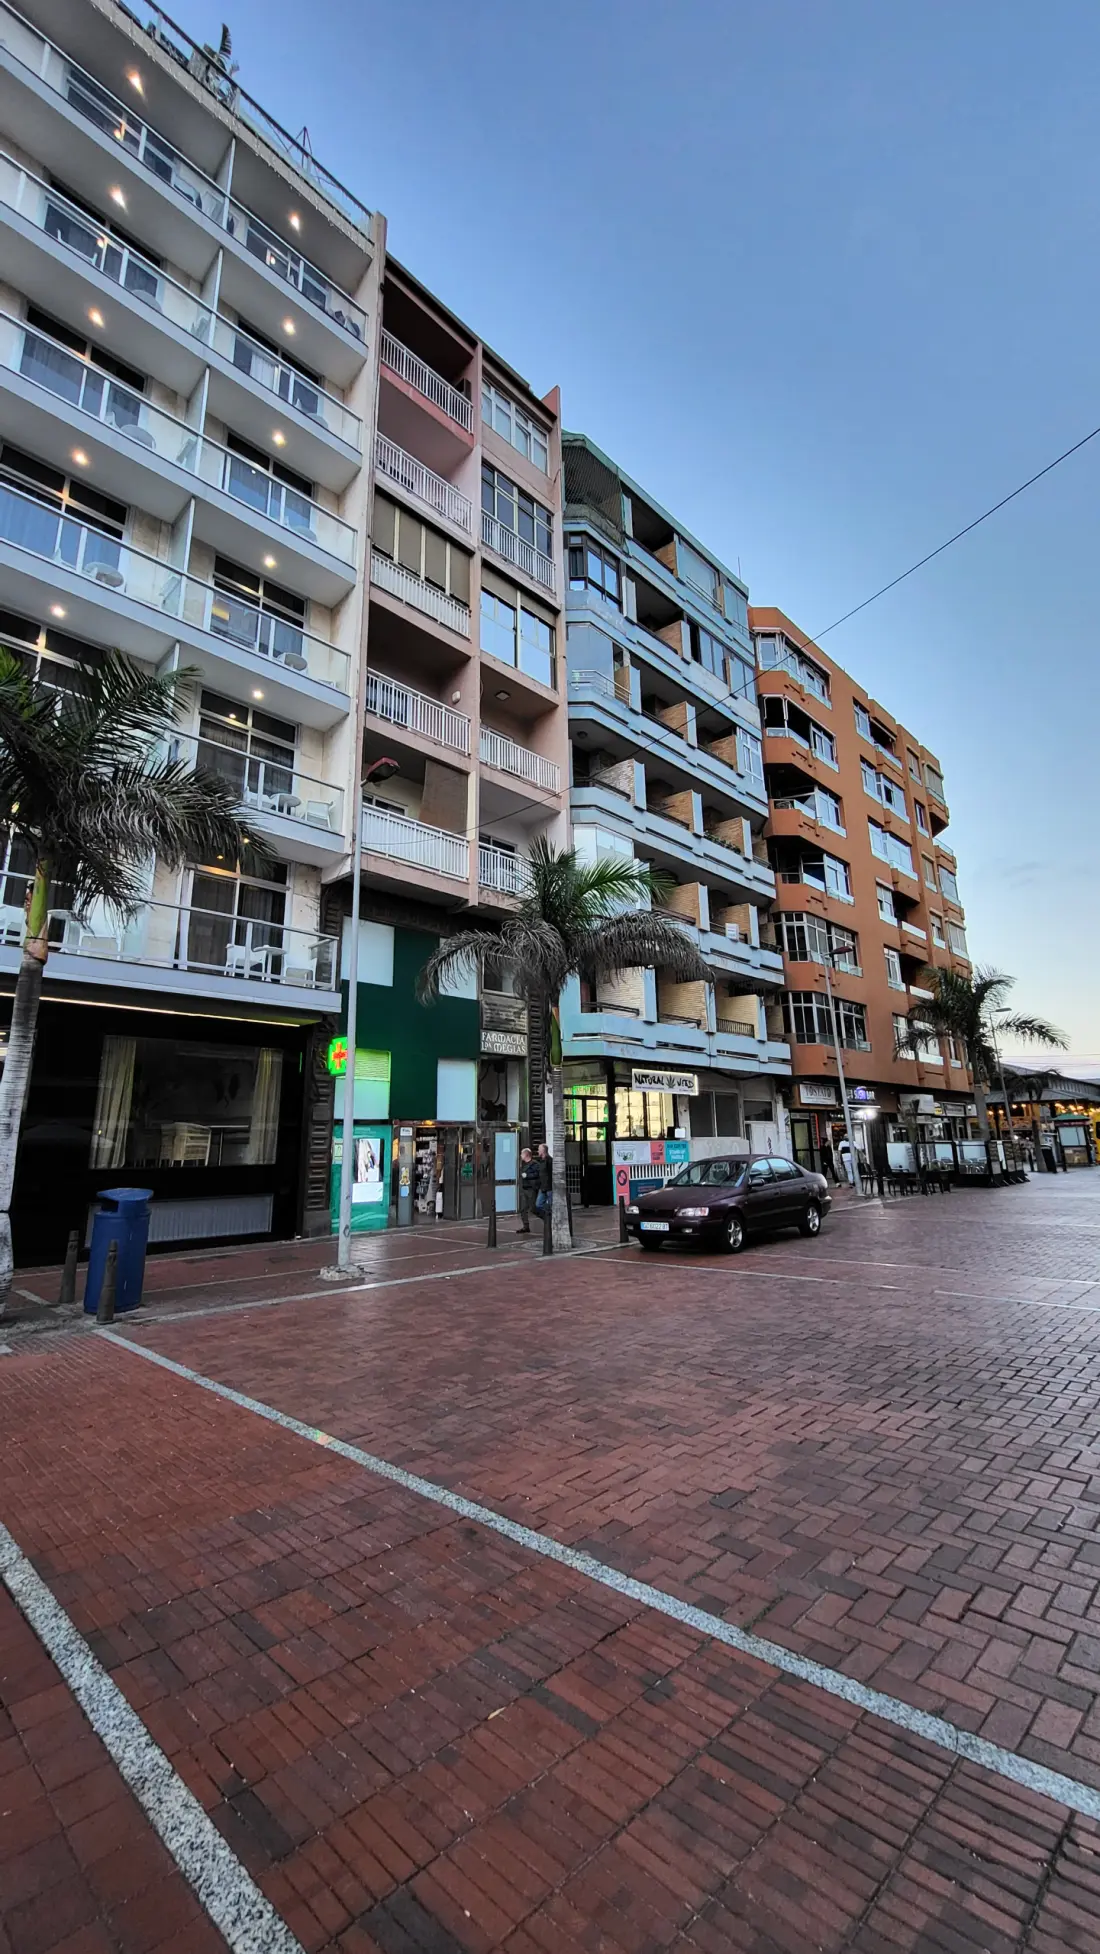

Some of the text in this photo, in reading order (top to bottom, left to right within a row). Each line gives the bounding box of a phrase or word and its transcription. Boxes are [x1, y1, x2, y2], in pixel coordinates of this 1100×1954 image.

[481, 1031, 526, 1045] FARMACIA
[493, 1043, 526, 1054] MEGIAS
[633, 1073, 665, 1086] NATURAL
